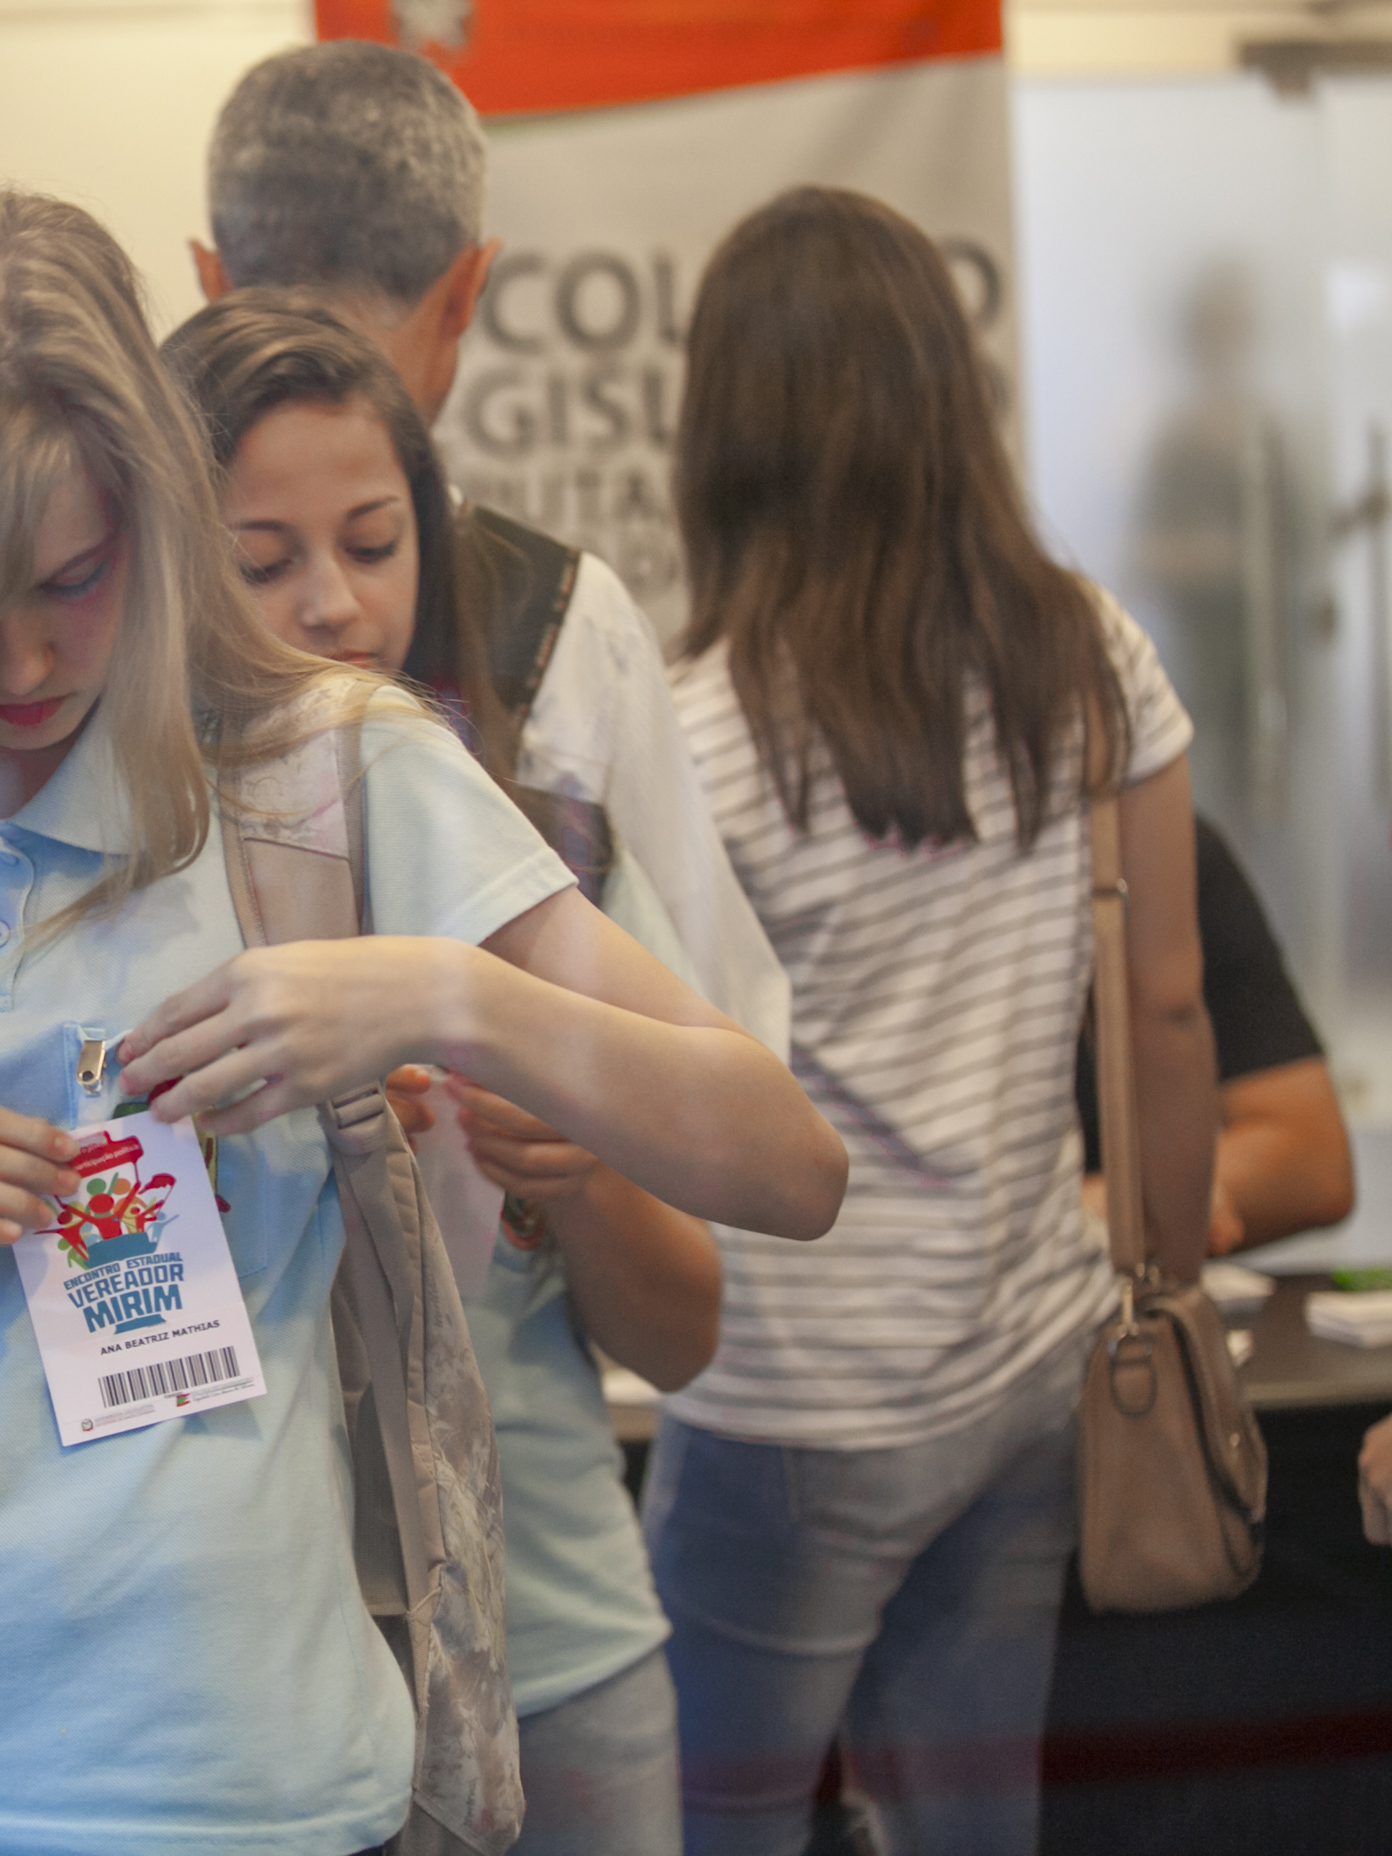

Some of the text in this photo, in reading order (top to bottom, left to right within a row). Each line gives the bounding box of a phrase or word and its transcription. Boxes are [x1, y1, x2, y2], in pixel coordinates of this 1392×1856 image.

[63, 1252, 183, 1291] ENCONTRO ESTADUAL
[67, 1263, 184, 1309] VEREADOR
[82, 1284, 183, 1333] MIRIM
[100, 1343, 123, 1356] ANA
[125, 1332, 170, 1350] BEATRIZ
[172, 1319, 220, 1338] MATHIAS
